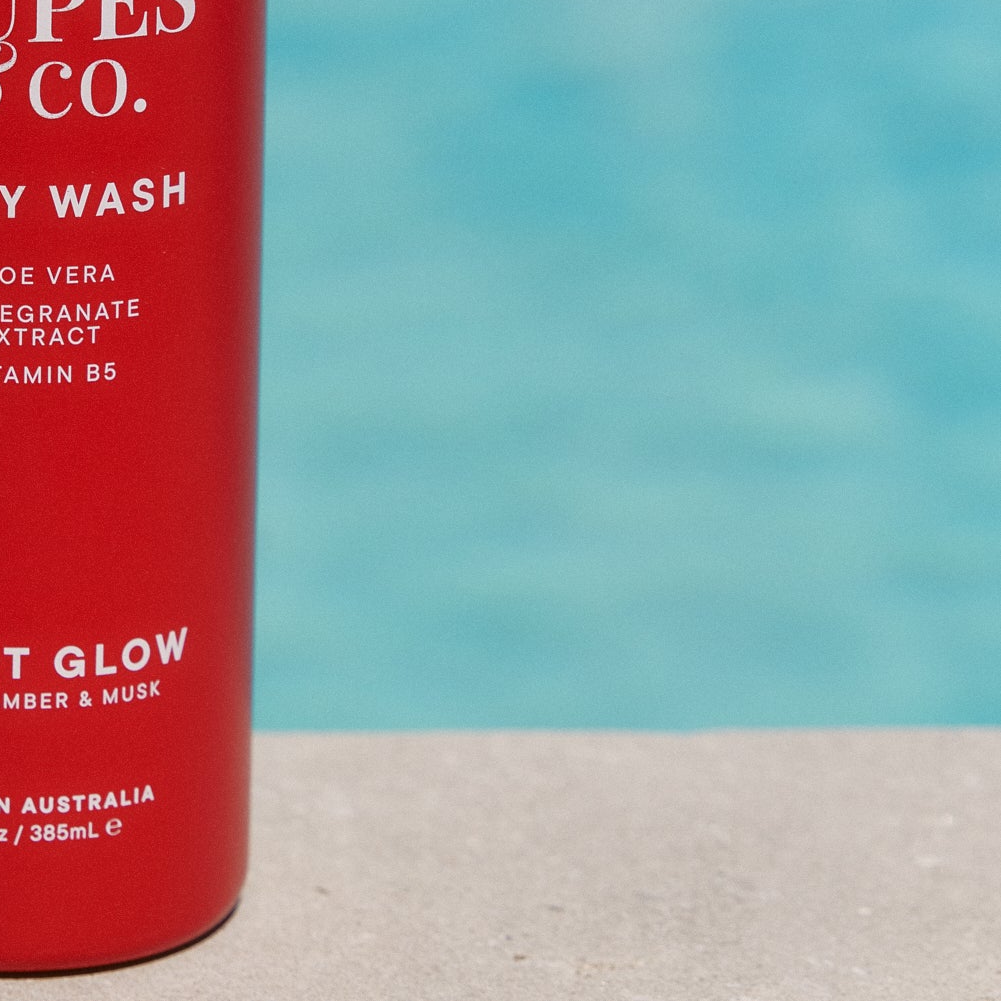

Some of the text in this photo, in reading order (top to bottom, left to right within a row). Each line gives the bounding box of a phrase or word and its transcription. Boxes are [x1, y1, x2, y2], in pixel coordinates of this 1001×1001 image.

[28, 58, 147, 120] CO.
[48, 171, 187, 219] WASH
[46, 263, 116, 285] VERA
[86, 361, 117, 383] B5
[53, 626, 188, 680] GLOW
[78, 690, 93, 709] &
[102, 679, 161, 706] MUSK
[20, 784, 156, 815] AUSTRALIA
[13, 823, 24, 846] /
[29, 821, 100, 842] 385mL
